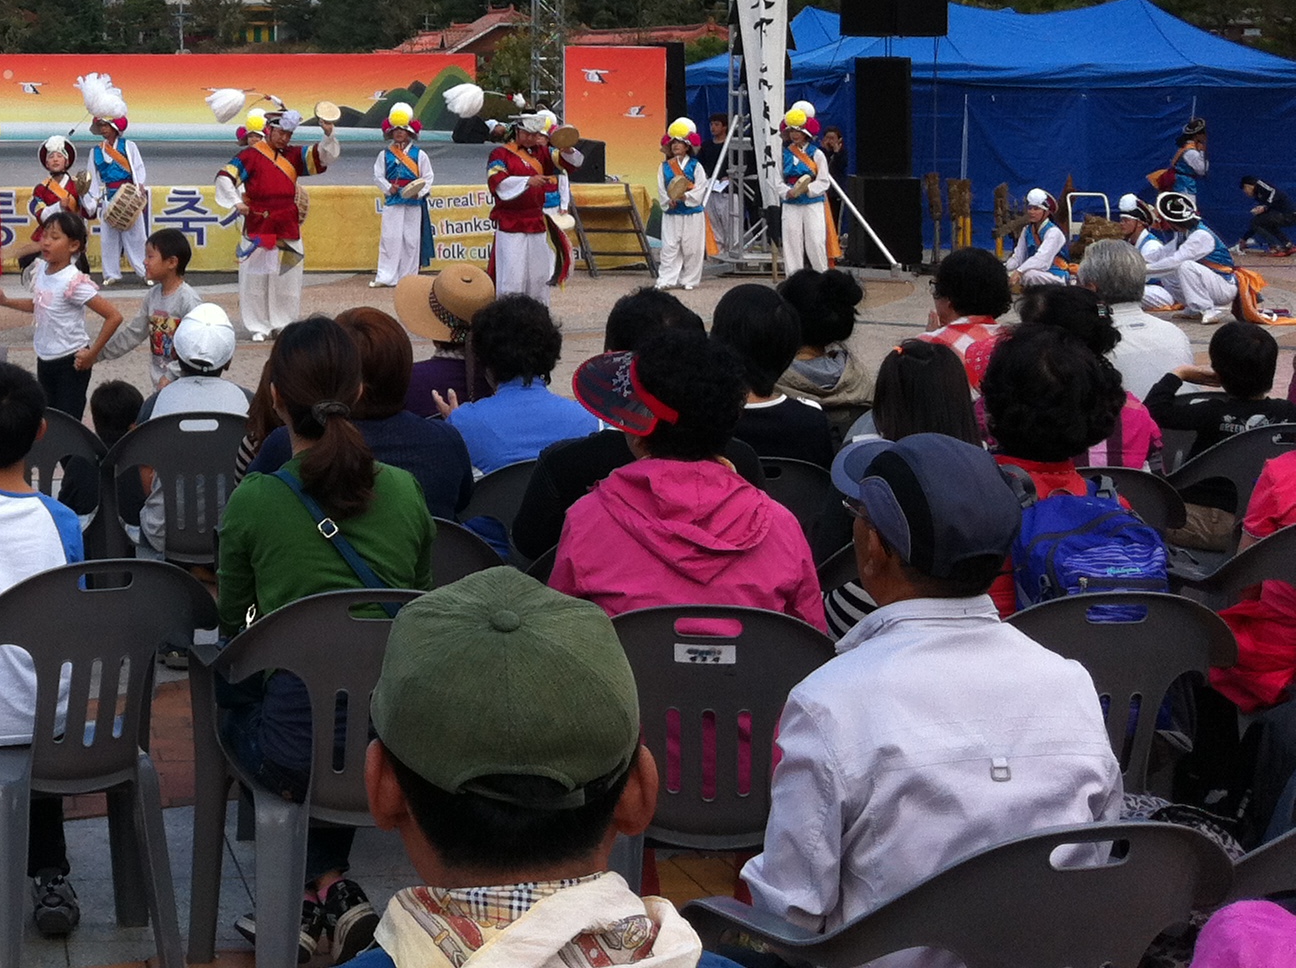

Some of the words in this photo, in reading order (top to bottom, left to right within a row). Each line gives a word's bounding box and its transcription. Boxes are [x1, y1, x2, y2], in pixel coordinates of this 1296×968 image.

[447, 195, 474, 209] real
[477, 191, 494, 207] Fu
[437, 243, 465, 260] folk
[469, 243, 491, 260] cul
